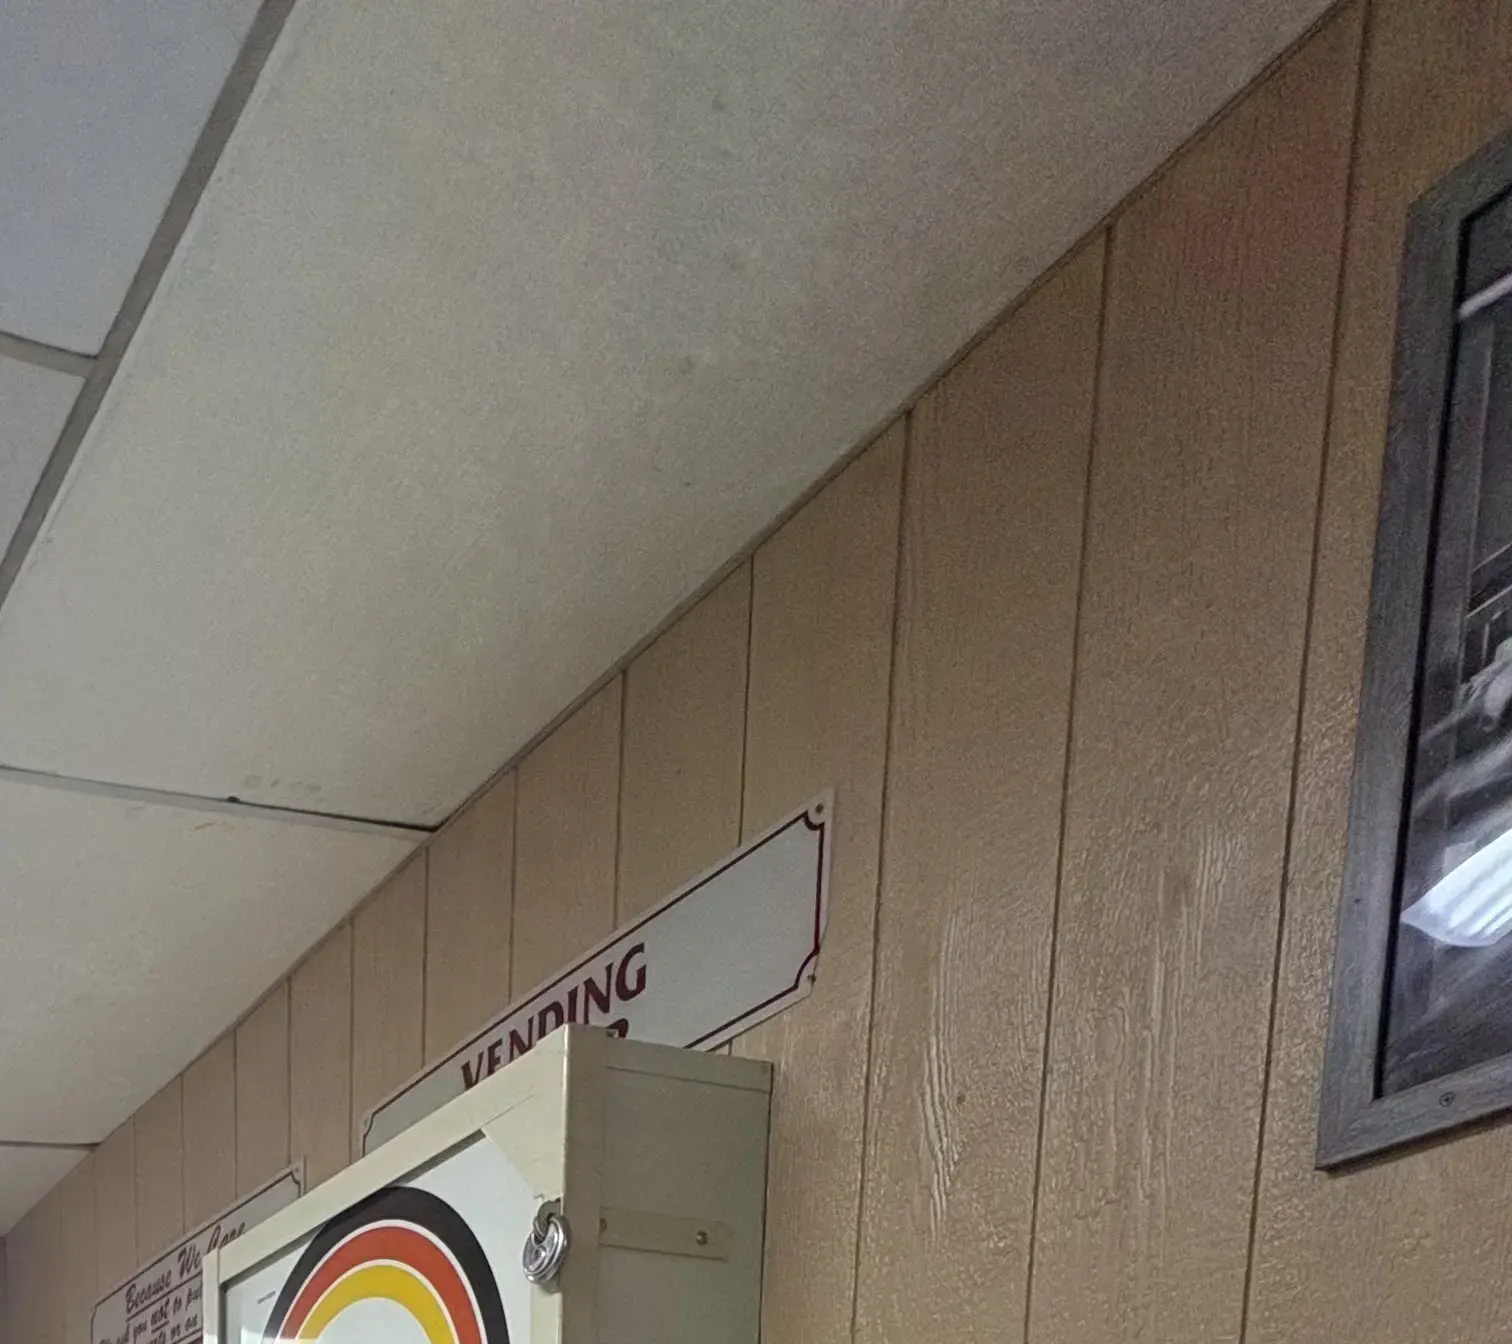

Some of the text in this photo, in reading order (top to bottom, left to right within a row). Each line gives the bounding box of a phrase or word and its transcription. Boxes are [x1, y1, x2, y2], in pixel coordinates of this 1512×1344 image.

[461, 942, 647, 1092] VENDING
[125, 1269, 171, 1314] Because
[177, 1244, 200, 1278] We
[151, 1297, 170, 1326] not
[173, 1296, 182, 1315] to
